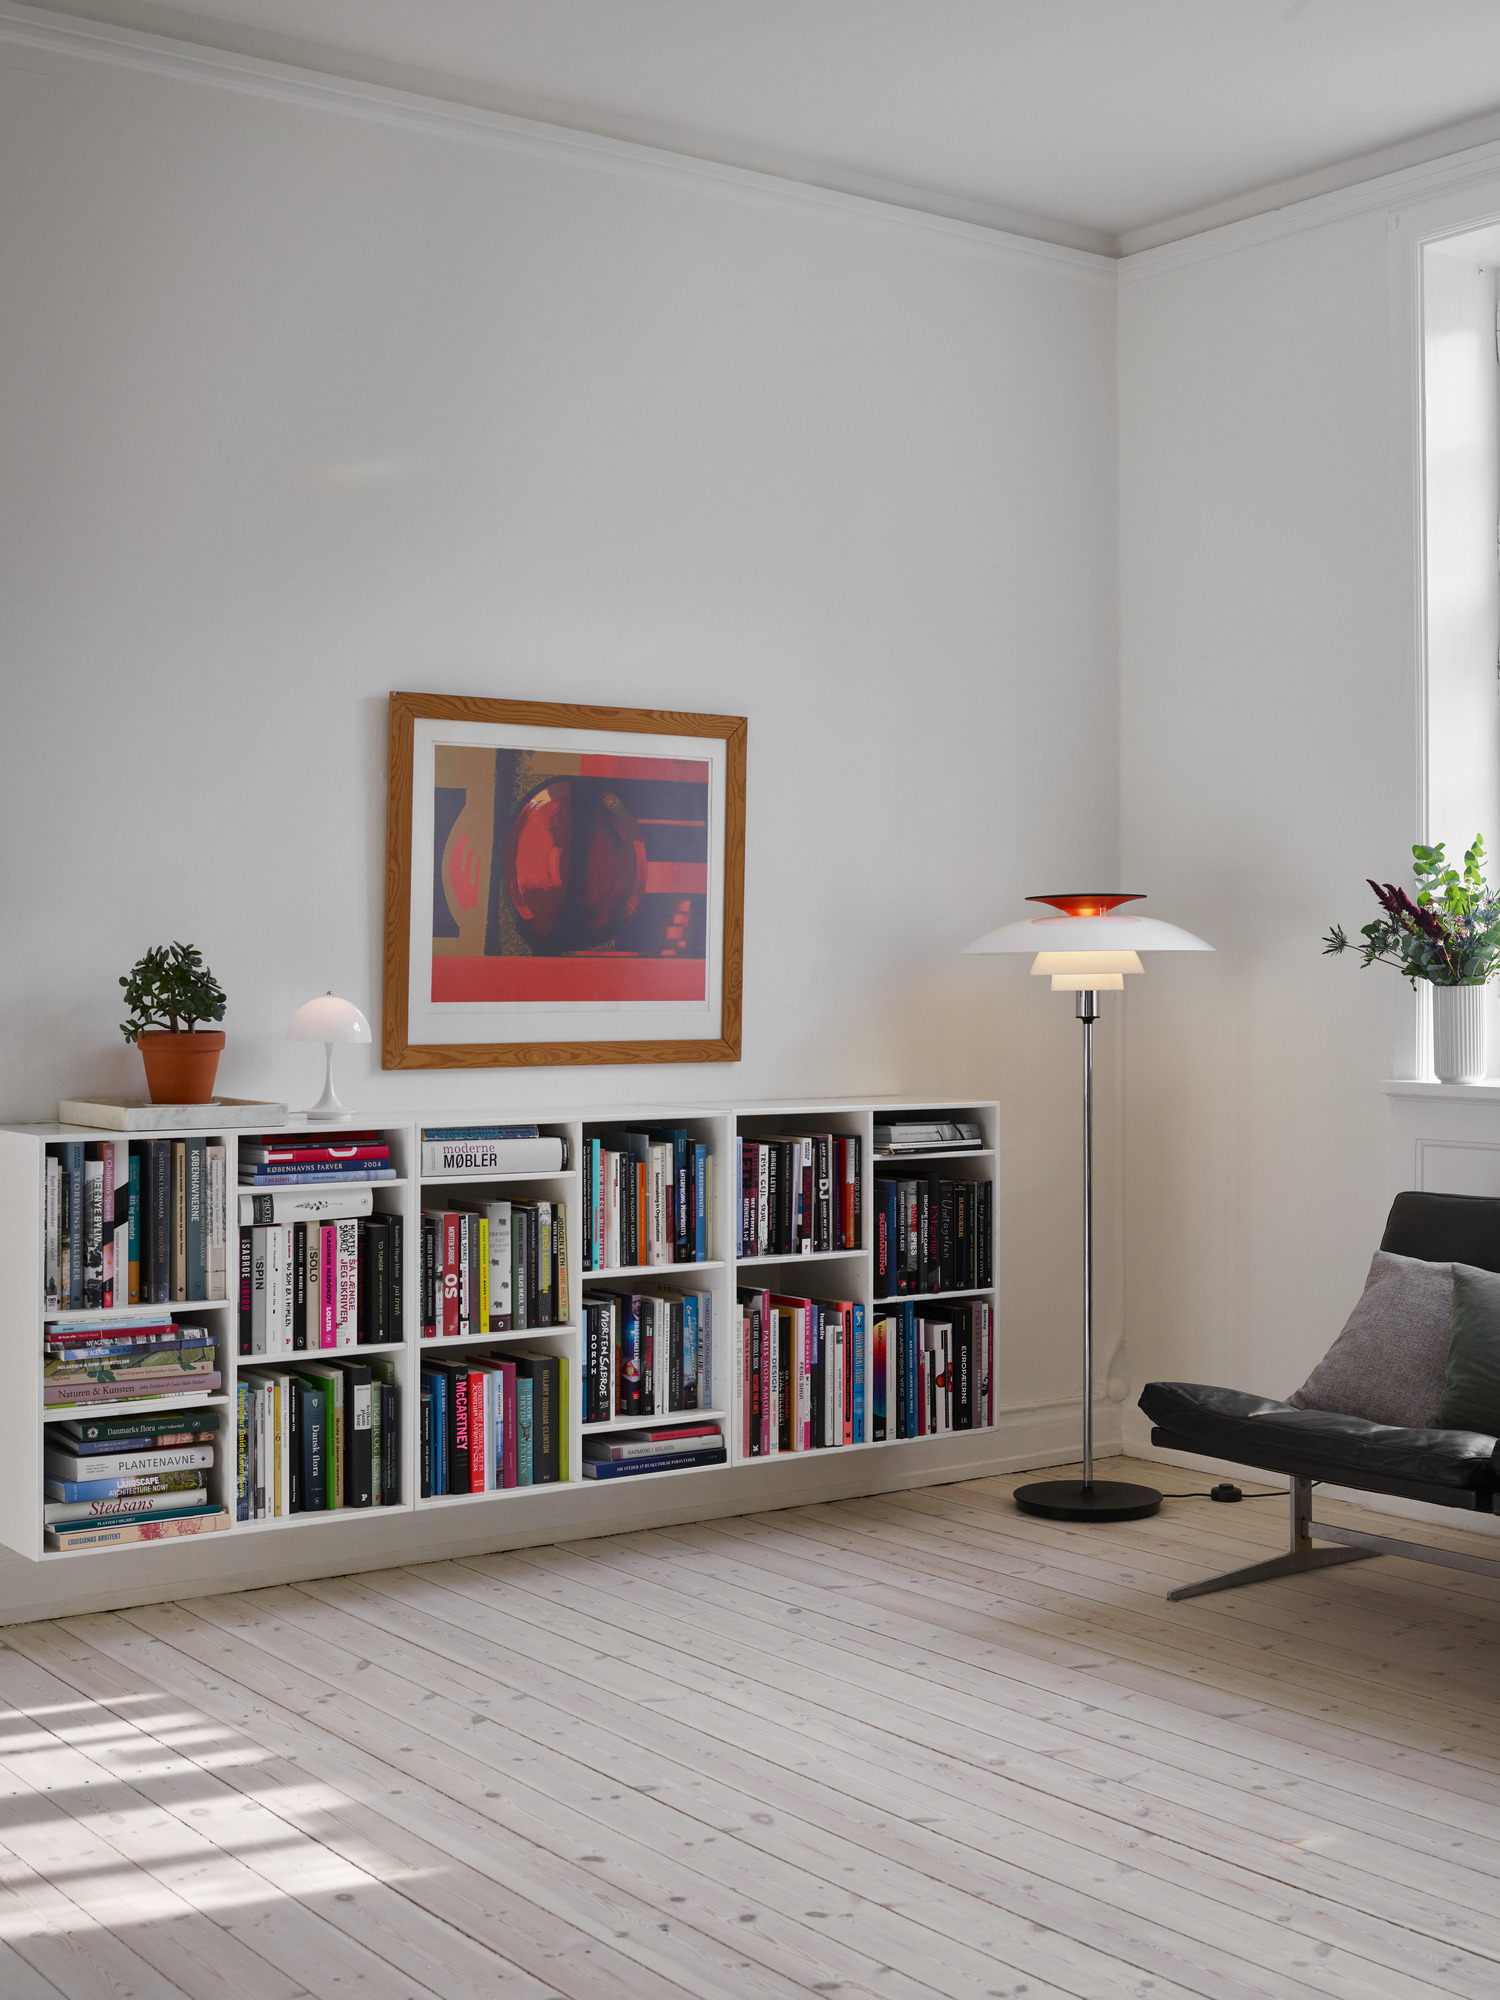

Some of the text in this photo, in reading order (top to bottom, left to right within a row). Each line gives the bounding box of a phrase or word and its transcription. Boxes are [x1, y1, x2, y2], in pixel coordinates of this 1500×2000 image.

[442, 1143, 495, 1154] moderne
[266, 1164, 315, 1173] KØBENHAVNS
[443, 1153, 497, 1169] MØBLER
[105, 1159, 114, 1220] Children's Spaces
[190, 1149, 200, 1222] KØBENHAVNERNE
[264, 1176, 290, 1184] Facaden
[819, 1178, 829, 1200] DJ
[73, 1171, 81, 1230] STORBYENS
[128, 1206, 134, 1215] og
[264, 1195, 272, 1223] FLORA
[128, 1216, 136, 1240] geodata
[941, 1199, 953, 1258] Undtagelsen
[340, 1224, 348, 1253] SABROE
[378, 1240, 384, 1249] TO
[73, 1233, 81, 1281] BILLEDER
[309, 1251, 318, 1282] SOLO
[348, 1259, 357, 1272] SÅ
[241, 1243, 250, 1310] SABROE LIBIDO
[255, 1261, 264, 1290] SPIN
[340, 1259, 348, 1322] JEG SKRIVER
[393, 1285, 400, 1296] på
[445, 1273, 458, 1299] OS
[646, 1337, 653, 1346] ET
[599, 1310, 610, 1397] MORTEN SABROE
[855, 1331, 864, 1385] GOVERNMENT ISSUE
[784, 1370, 789, 1381] DA
[58, 1385, 135, 1399] Naturen & Kunsten
[456, 1381, 468, 1450] McCARTNEY
[107, 1424, 156, 1436] Danmarks flora
[312, 1424, 320, 1477] Dansk flora
[373, 1437, 381, 1453] OG
[627, 1448, 651, 1456] HARMONI
[654, 1445, 675, 1453] BOLIGEN
[118, 1454, 195, 1471] PLANTENAVNE
[373, 1455, 381, 1486] BUSKE
[108, 1486, 152, 1497] ARCHITECTURE
[116, 1477, 159, 1489] LANDSCAPE
[88, 1497, 154, 1516] Stedsans
[67, 1532, 121, 1546] LOUISIANAS ARKITEKT
